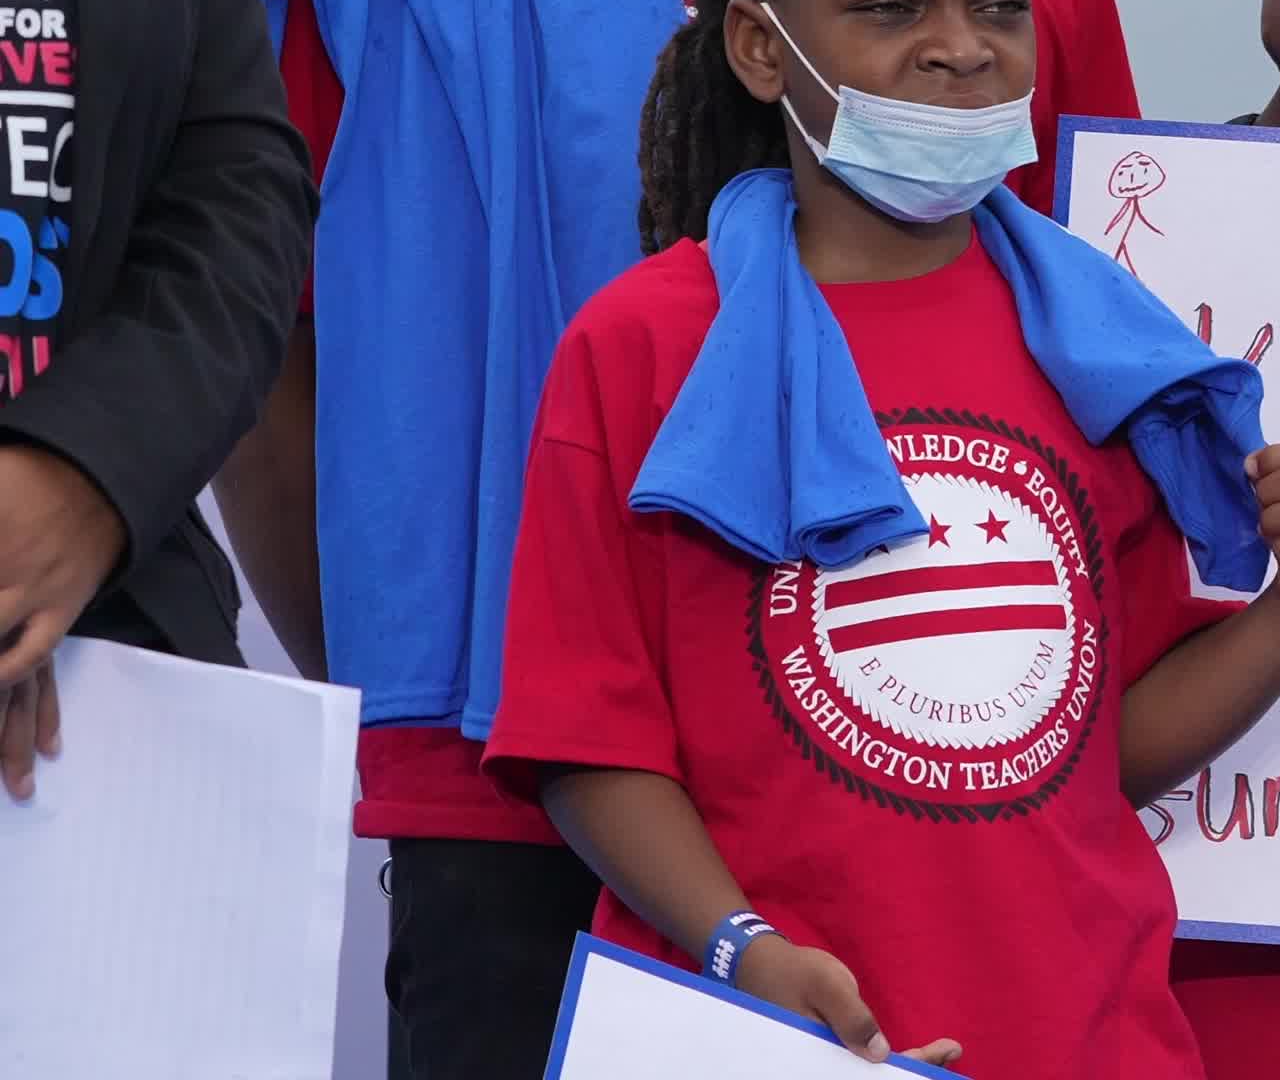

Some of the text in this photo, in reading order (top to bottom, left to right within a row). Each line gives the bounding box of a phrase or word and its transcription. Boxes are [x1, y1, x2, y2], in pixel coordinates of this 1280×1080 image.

[1025, 467, 1090, 579] EQUITY
[781, 644, 952, 790] WASHINGTON
[1065, 619, 1098, 722] UNION
[859, 639, 1055, 725] E PLURIBUS UNUM
